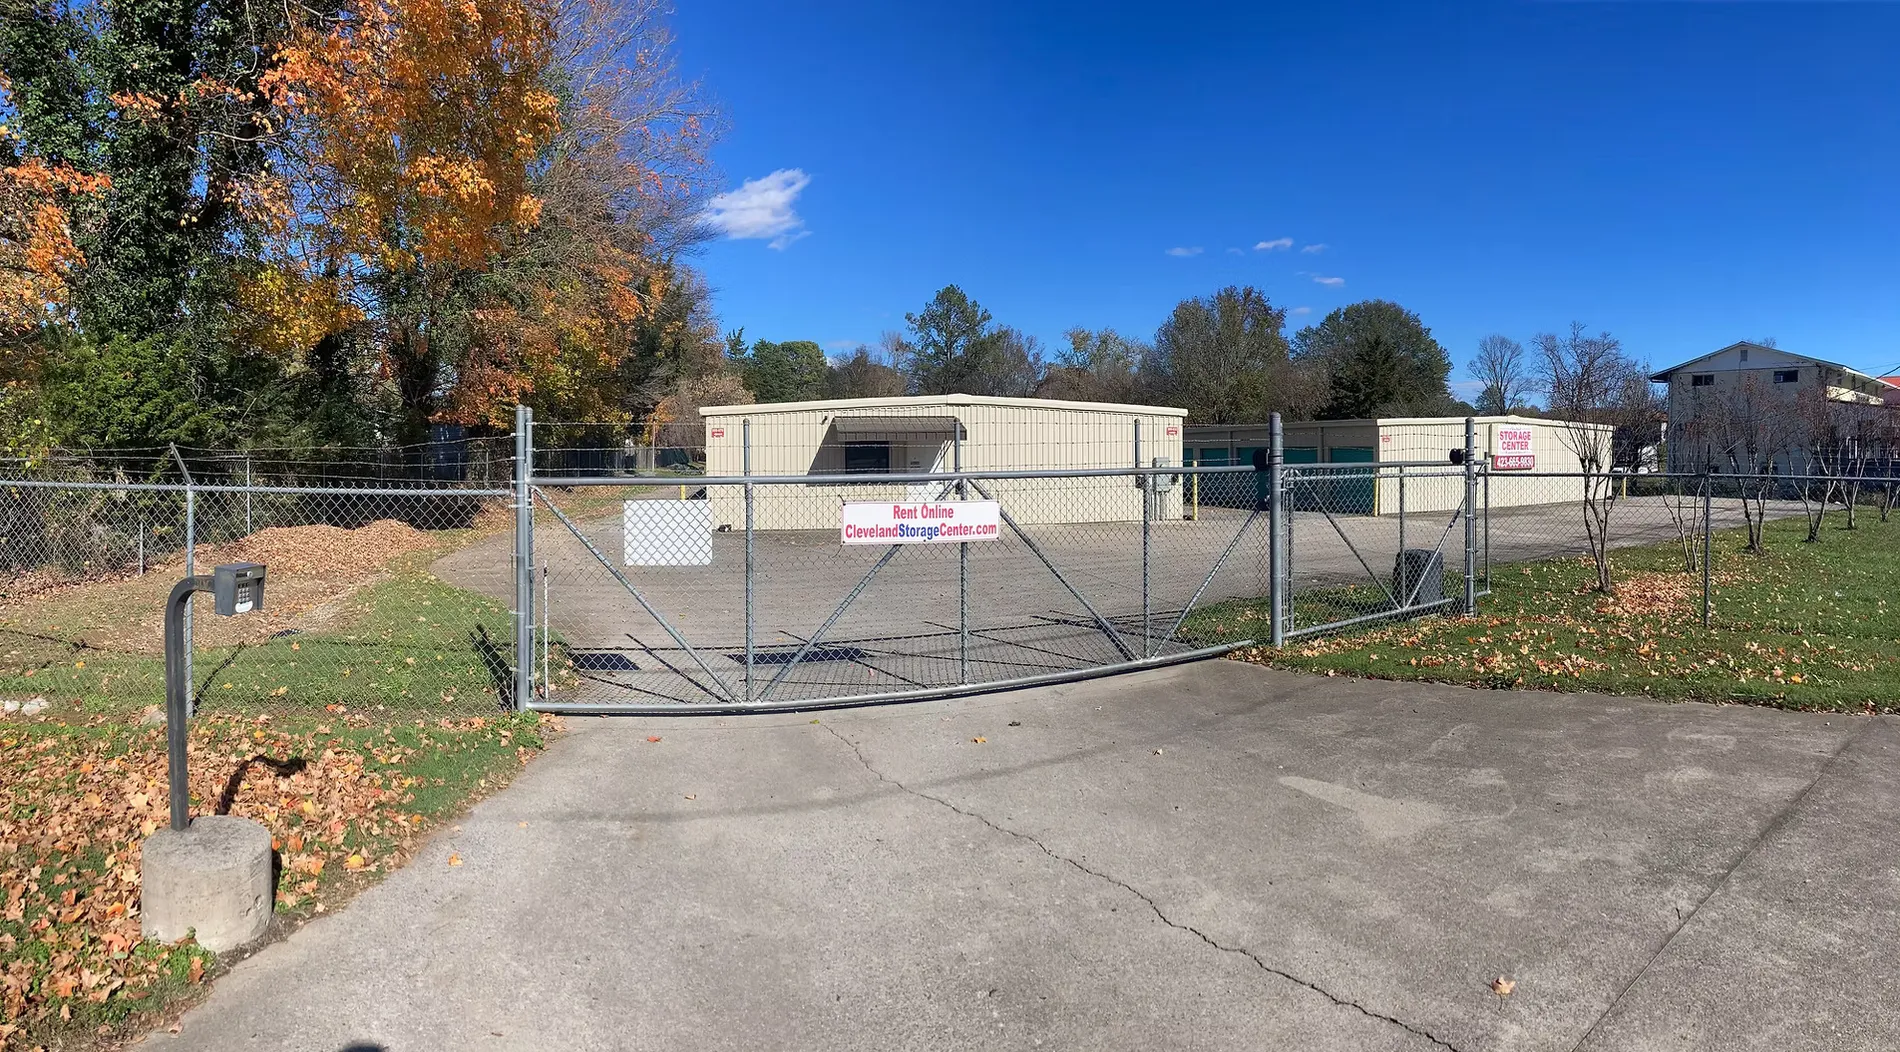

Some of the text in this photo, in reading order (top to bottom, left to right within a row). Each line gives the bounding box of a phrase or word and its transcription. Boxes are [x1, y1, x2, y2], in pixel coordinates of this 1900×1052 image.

[1499, 430, 1531, 440] STORAGE
[1501, 441, 1529, 450] CENTER
[893, 504, 954, 519] Rent Online
[845, 523, 997, 540] ClevelandStorageCenter.com
